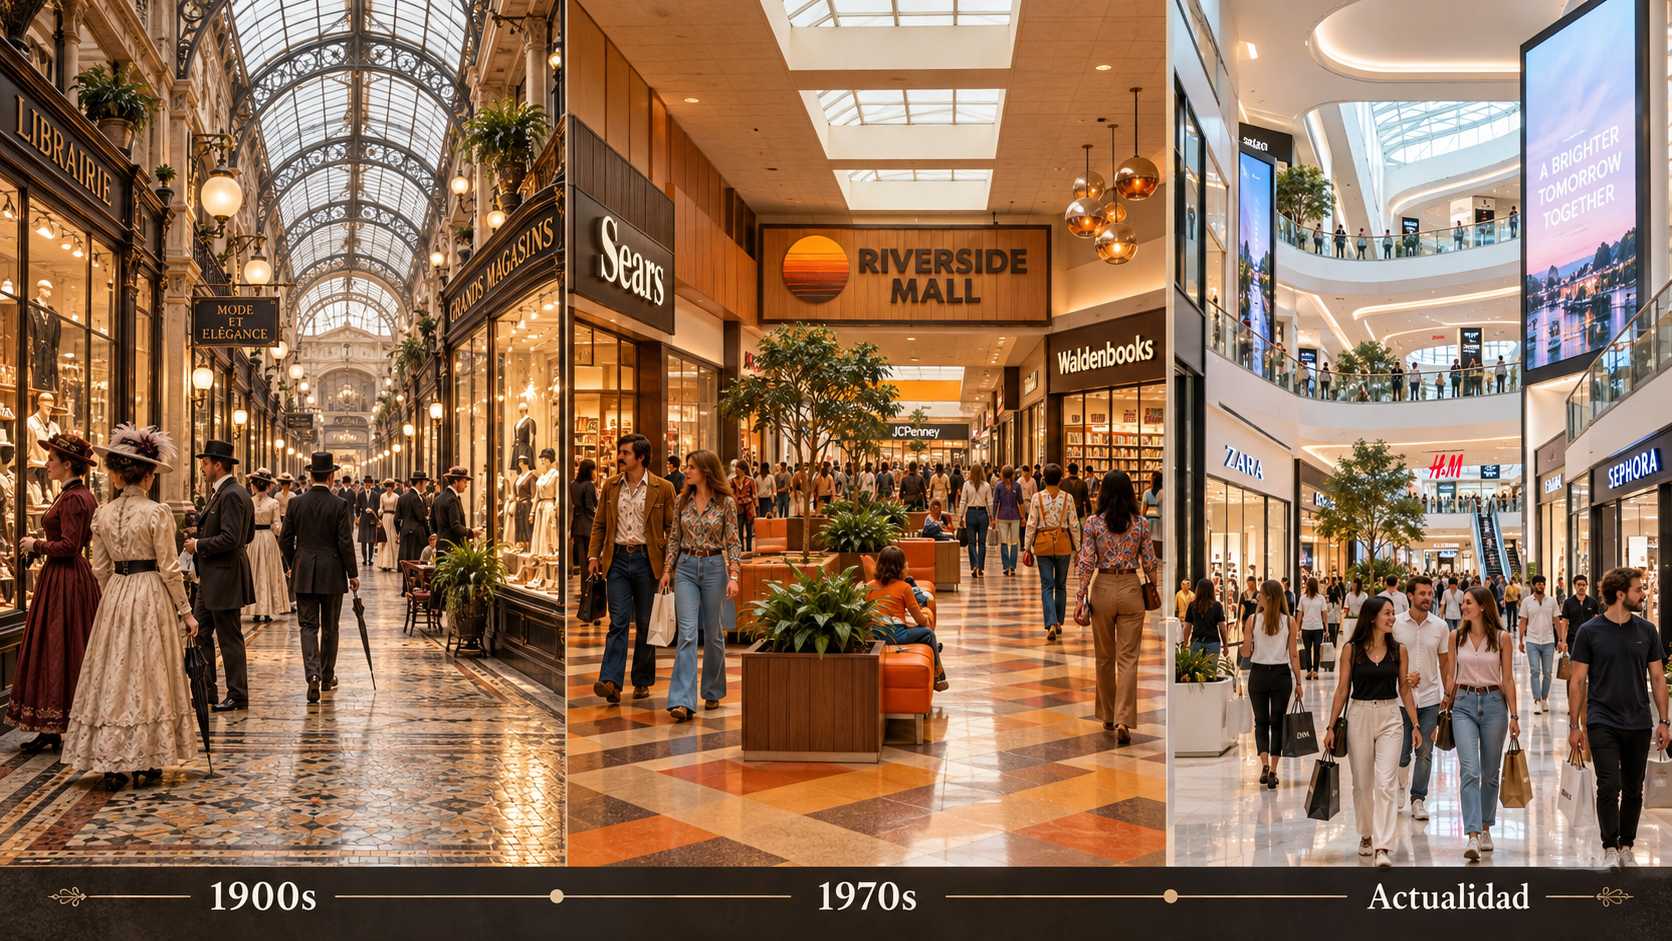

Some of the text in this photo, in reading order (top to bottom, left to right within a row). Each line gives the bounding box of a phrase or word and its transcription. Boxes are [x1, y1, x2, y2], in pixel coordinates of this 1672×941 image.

[16, 94, 113, 208] LIBRAIRIE
[1539, 125, 1620, 182] A BRIGHTER
[1537, 150, 1623, 206] TOMORROW
[1543, 183, 1615, 230] TOGETHER
[449, 216, 554, 324] GRANDS MAGASINS
[600, 215, 665, 307] Sears
[858, 248, 1028, 275] RIVERSIDE
[217, 304, 254, 316] MODE
[890, 278, 981, 304] MALL
[228, 316, 244, 328] ET
[1057, 334, 1155, 376] Waldenbooks
[891, 425, 940, 440] JCPenney
[1223, 444, 1265, 482] ZARA
[1608, 447, 1658, 490] SEPHORA
